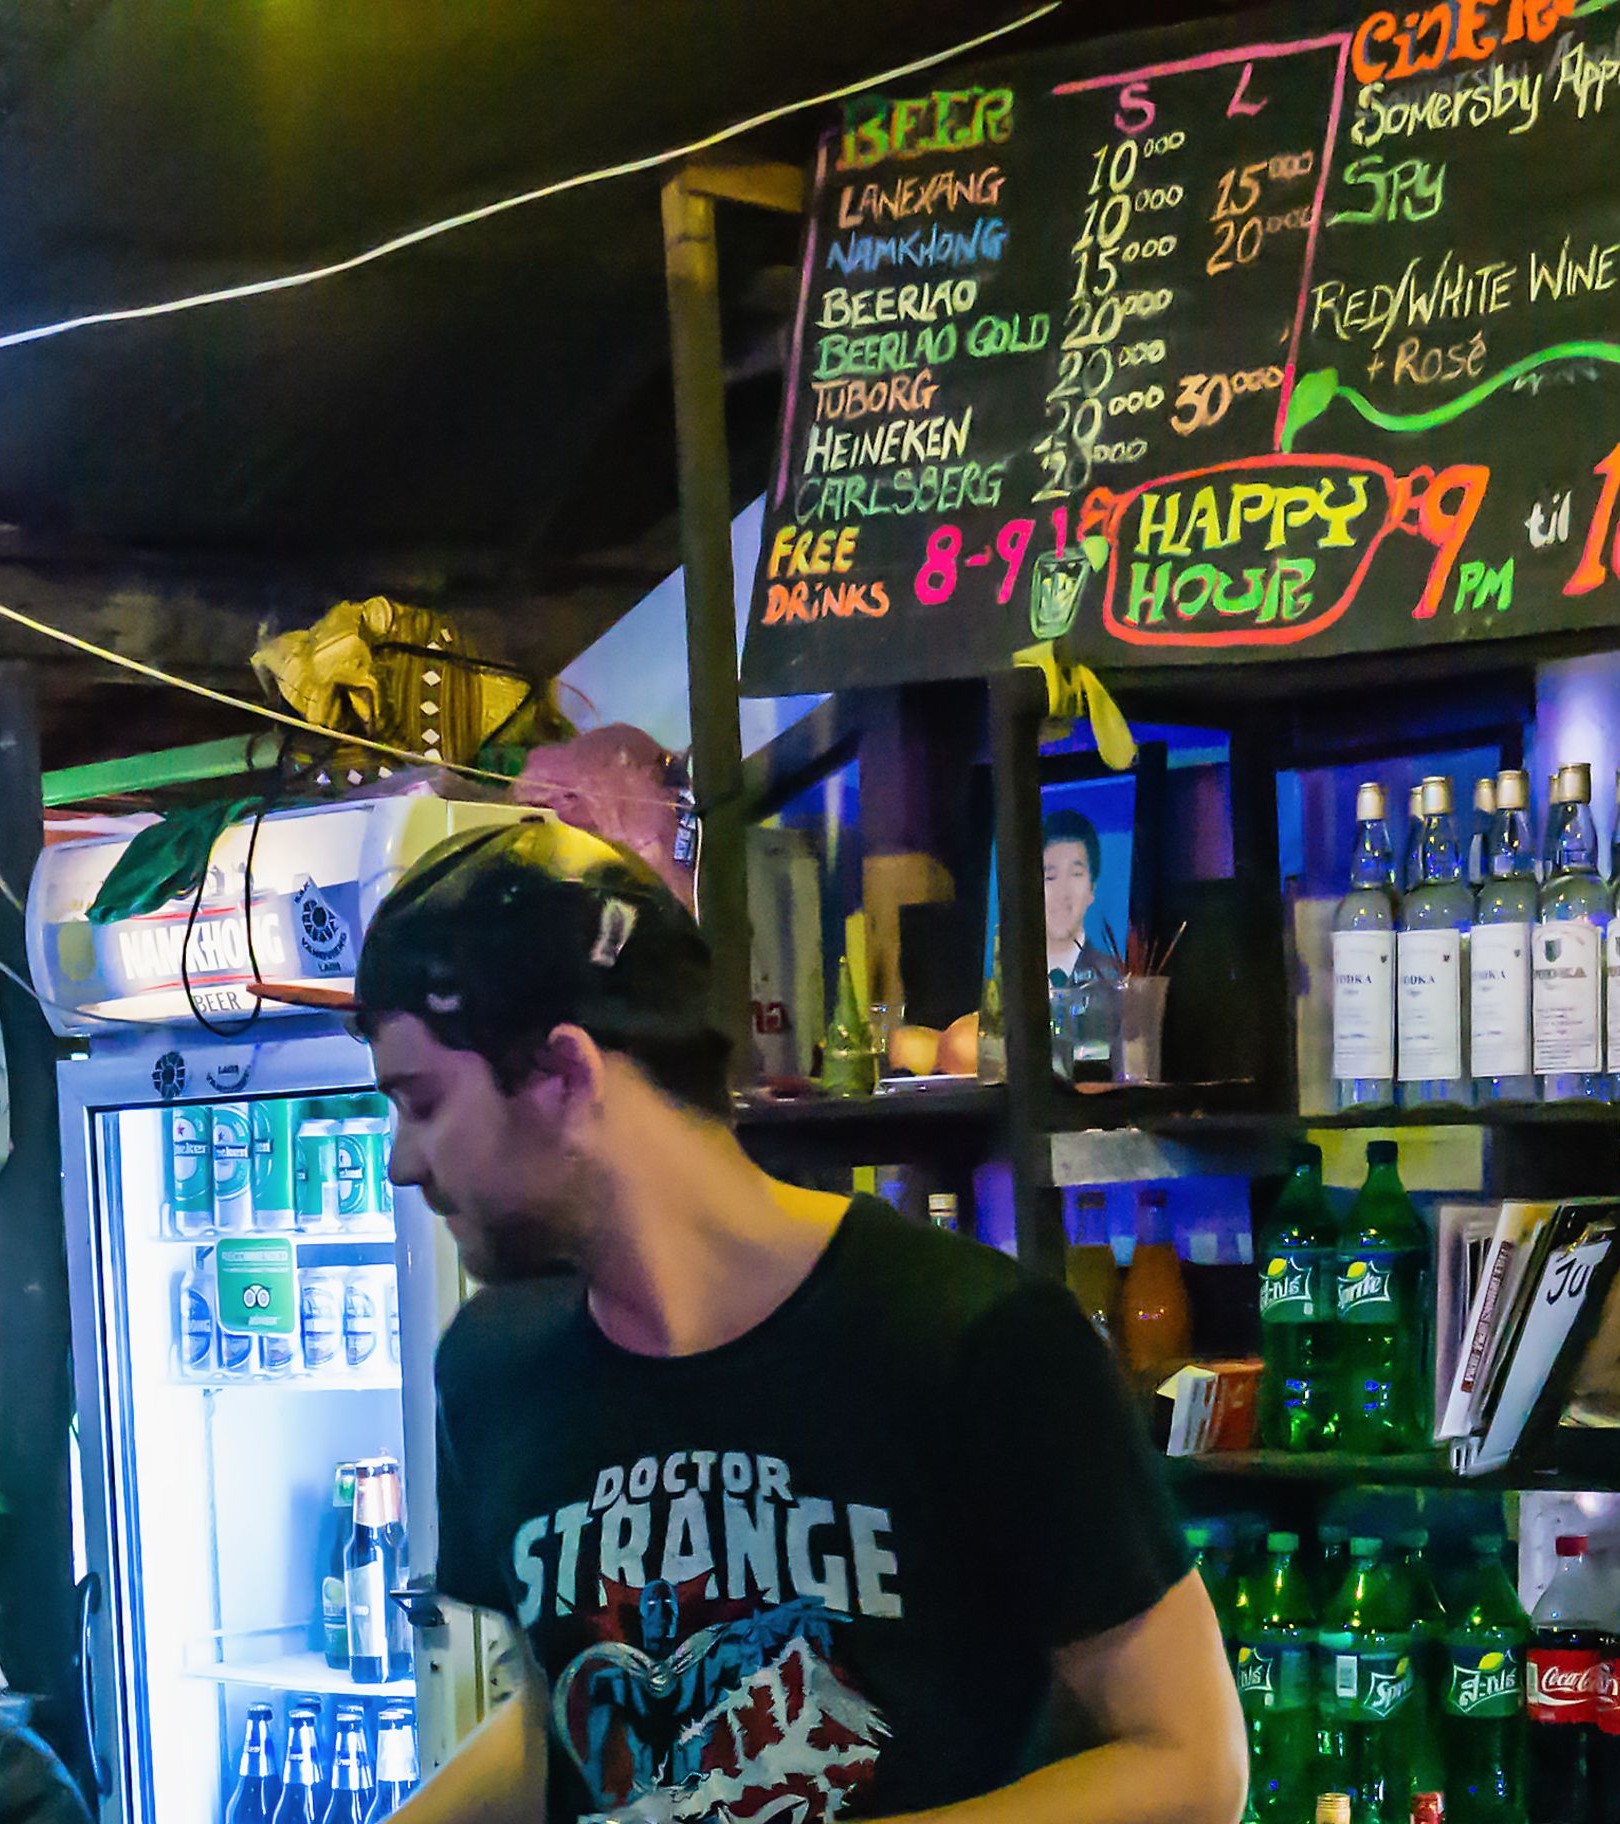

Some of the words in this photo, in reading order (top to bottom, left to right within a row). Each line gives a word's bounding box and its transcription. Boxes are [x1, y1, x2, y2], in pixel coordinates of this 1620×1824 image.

[837, 85, 1014, 172] BEER
[1114, 83, 1156, 134] S
[1227, 63, 1268, 119] L
[815, 280, 978, 330] BEERLAO
[815, 327, 958, 380] BEERLAO
[967, 312, 1051, 357] GOLD
[811, 367, 941, 422] TUBORG
[803, 406, 974, 475] HEINEKEN
[794, 464, 1012, 525] CARLSBERG
[1134, 474, 1369, 557] HAPPY
[767, 525, 862, 580] FREE
[1412, 464, 1491, 619] 9
[1452, 556, 1516, 616] PM
[1525, 490, 1572, 549] til
[1123, 558, 1318, 629] HOUR
[118, 913, 286, 981] NAMKHONG
[192, 990, 242, 1014] BEER
[590, 1448, 797, 1512] DOCTOR
[511, 1488, 906, 1628] STRANGE
